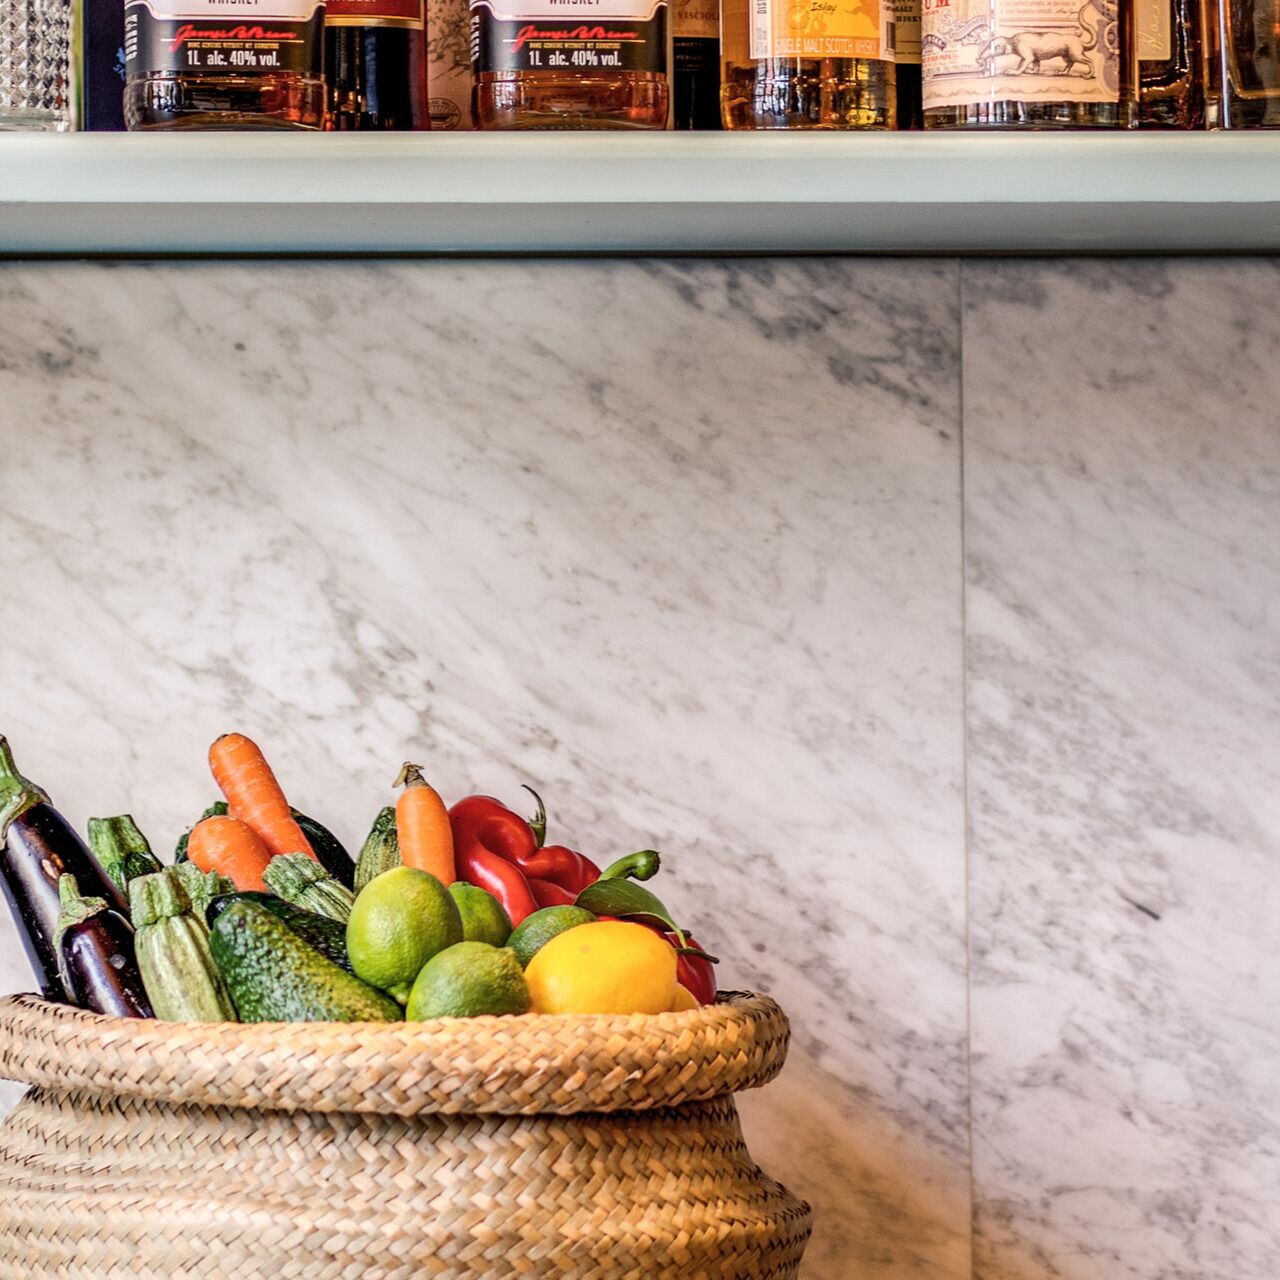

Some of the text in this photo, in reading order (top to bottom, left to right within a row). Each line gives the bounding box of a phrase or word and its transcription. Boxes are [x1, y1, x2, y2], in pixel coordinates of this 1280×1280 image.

[775, 38, 801, 54] SINGLE
[803, 38, 824, 54] MALT
[825, 38, 853, 54] SCOTCH
[187, 50, 281, 66] 1L alc. 40% vol.
[528, 50, 622, 66] 1L alc. 40% vol.
